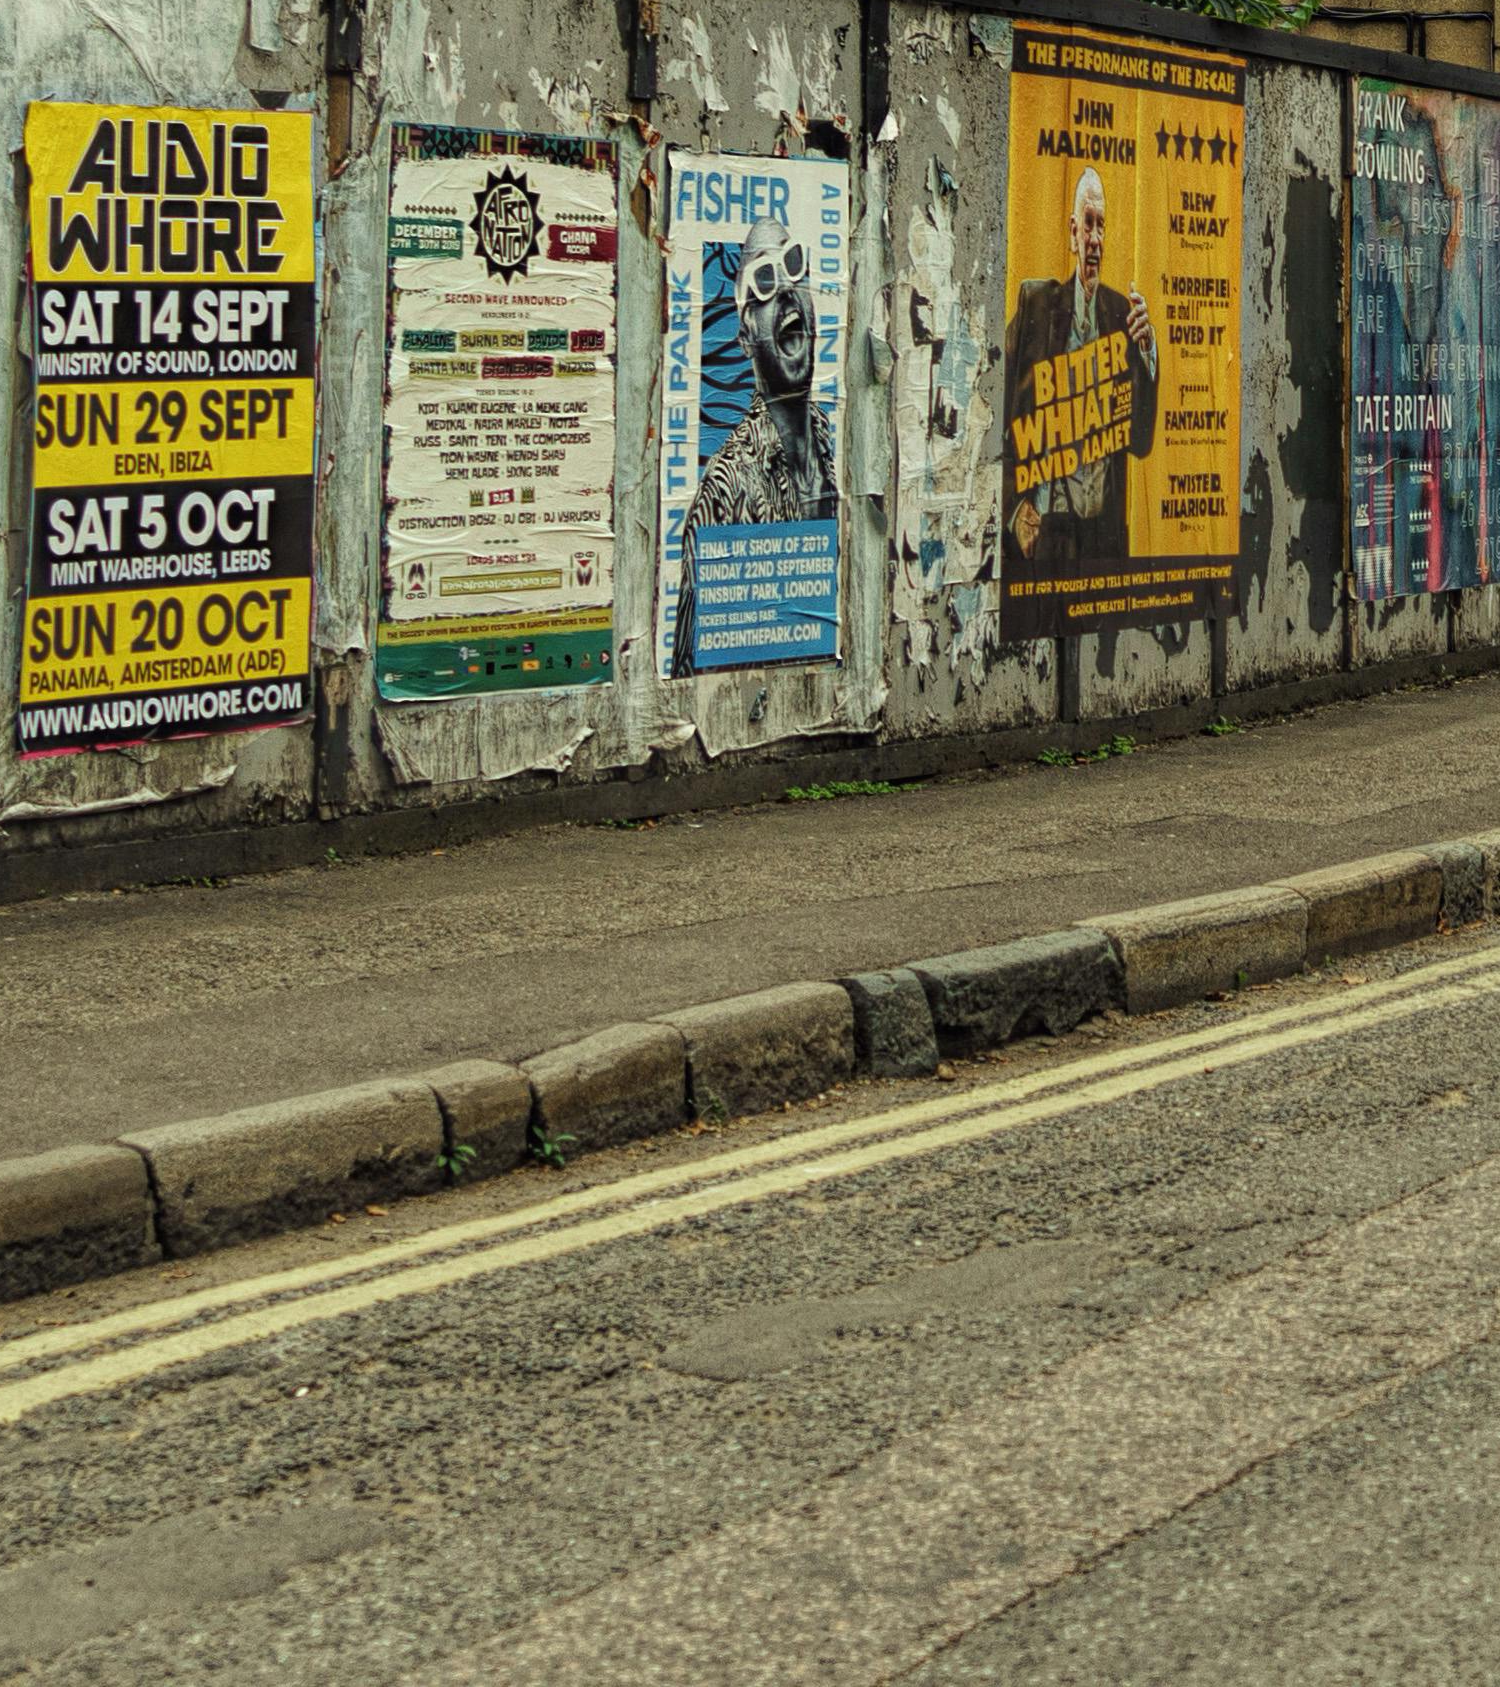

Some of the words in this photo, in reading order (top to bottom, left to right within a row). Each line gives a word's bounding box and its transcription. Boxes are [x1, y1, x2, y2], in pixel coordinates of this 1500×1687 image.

[1026, 40, 1058, 69] THE
[1151, 60, 1168, 84] OF
[1169, 64, 1193, 88] THE
[1357, 89, 1407, 133] FRANK
[66, 118, 270, 200] AUDIO
[1355, 140, 1426, 185] BOWLING
[676, 169, 790, 227] FISHER
[48, 196, 287, 275] WHORE
[394, 223, 457, 240] DECEMBER
[558, 230, 598, 246] GHANA
[1168, 212, 1185, 236] ME
[41, 288, 121, 347] SAT
[134, 289, 183, 344] 14
[191, 288, 290, 344] SEPT
[444, 292, 483, 305] SECOND
[484, 294, 509, 306] WAVE
[511, 294, 568, 307] ANNOUNCED
[1355, 294, 1385, 334] ARE
[461, 332, 499, 348] BURNA
[501, 332, 525, 348] BOY
[668, 268, 692, 392] PARK
[819, 314, 840, 364] IN
[1168, 322, 1205, 346] LOVED
[115, 350, 143, 376] OF
[144, 349, 216, 377] SOUND,
[218, 348, 297, 373] LONDON
[1032, 329, 1130, 408] BITTER
[35, 391, 120, 450] SUN
[134, 389, 188, 445] 29
[198, 387, 295, 443] SEPT
[426, 418, 468, 432] MEDIKAL
[506, 417, 543, 431] MARLEY
[536, 401, 562, 414] MEME
[563, 400, 589, 414] GANG
[1355, 394, 1390, 433] TATE
[1394, 394, 1453, 433] BRITAIN
[413, 434, 442, 448] RUSS
[448, 434, 479, 448] SANTI
[514, 433, 531, 446] THE
[506, 449, 540, 463] WENDY
[541, 448, 566, 461] SHAY
[666, 405, 688, 496] THE
[113, 452, 165, 478] EDEN,
[169, 450, 213, 474] IBIZA
[471, 466, 500, 479] ALADE
[534, 464, 561, 478] BANE
[1014, 448, 1079, 495] DAVID
[47, 495, 130, 557] SAT
[137, 493, 168, 550] 5
[177, 488, 276, 547] OCT
[398, 515, 467, 531] DISTRUCTION
[468, 513, 497, 527] BOYZ
[503, 512, 515, 525] DJ
[543, 510, 556, 524] DJ
[699, 541, 729, 560] FINAL
[731, 539, 747, 556] UK
[749, 537, 783, 555] SHOW
[784, 536, 800, 553] OF
[802, 534, 830, 552] 2019
[50, 561, 98, 587] MINT
[99, 552, 218, 583] WAREHOUSE,
[221, 548, 272, 574] LEEDS
[698, 562, 743, 582] SUNDAY
[743, 560, 774, 579] 22ND
[775, 556, 835, 577] SEPTEMBER
[699, 584, 750, 605] FINSBURY
[751, 582, 783, 601] PARK,
[784, 579, 832, 599] LONDON
[28, 601, 116, 664] SUN
[129, 596, 185, 654] 20
[196, 588, 293, 647] OCT
[698, 612, 727, 628] TICKETS
[727, 610, 758, 624] SELLING
[698, 623, 822, 652] ABODEINTHEPARK.COM
[28, 665, 115, 696] PANAMA,
[119, 653, 233, 687] AMSTERDAM
[236, 648, 287, 681] (ADE)
[19, 682, 303, 741] WWW.AUDIOWHORE.COM
